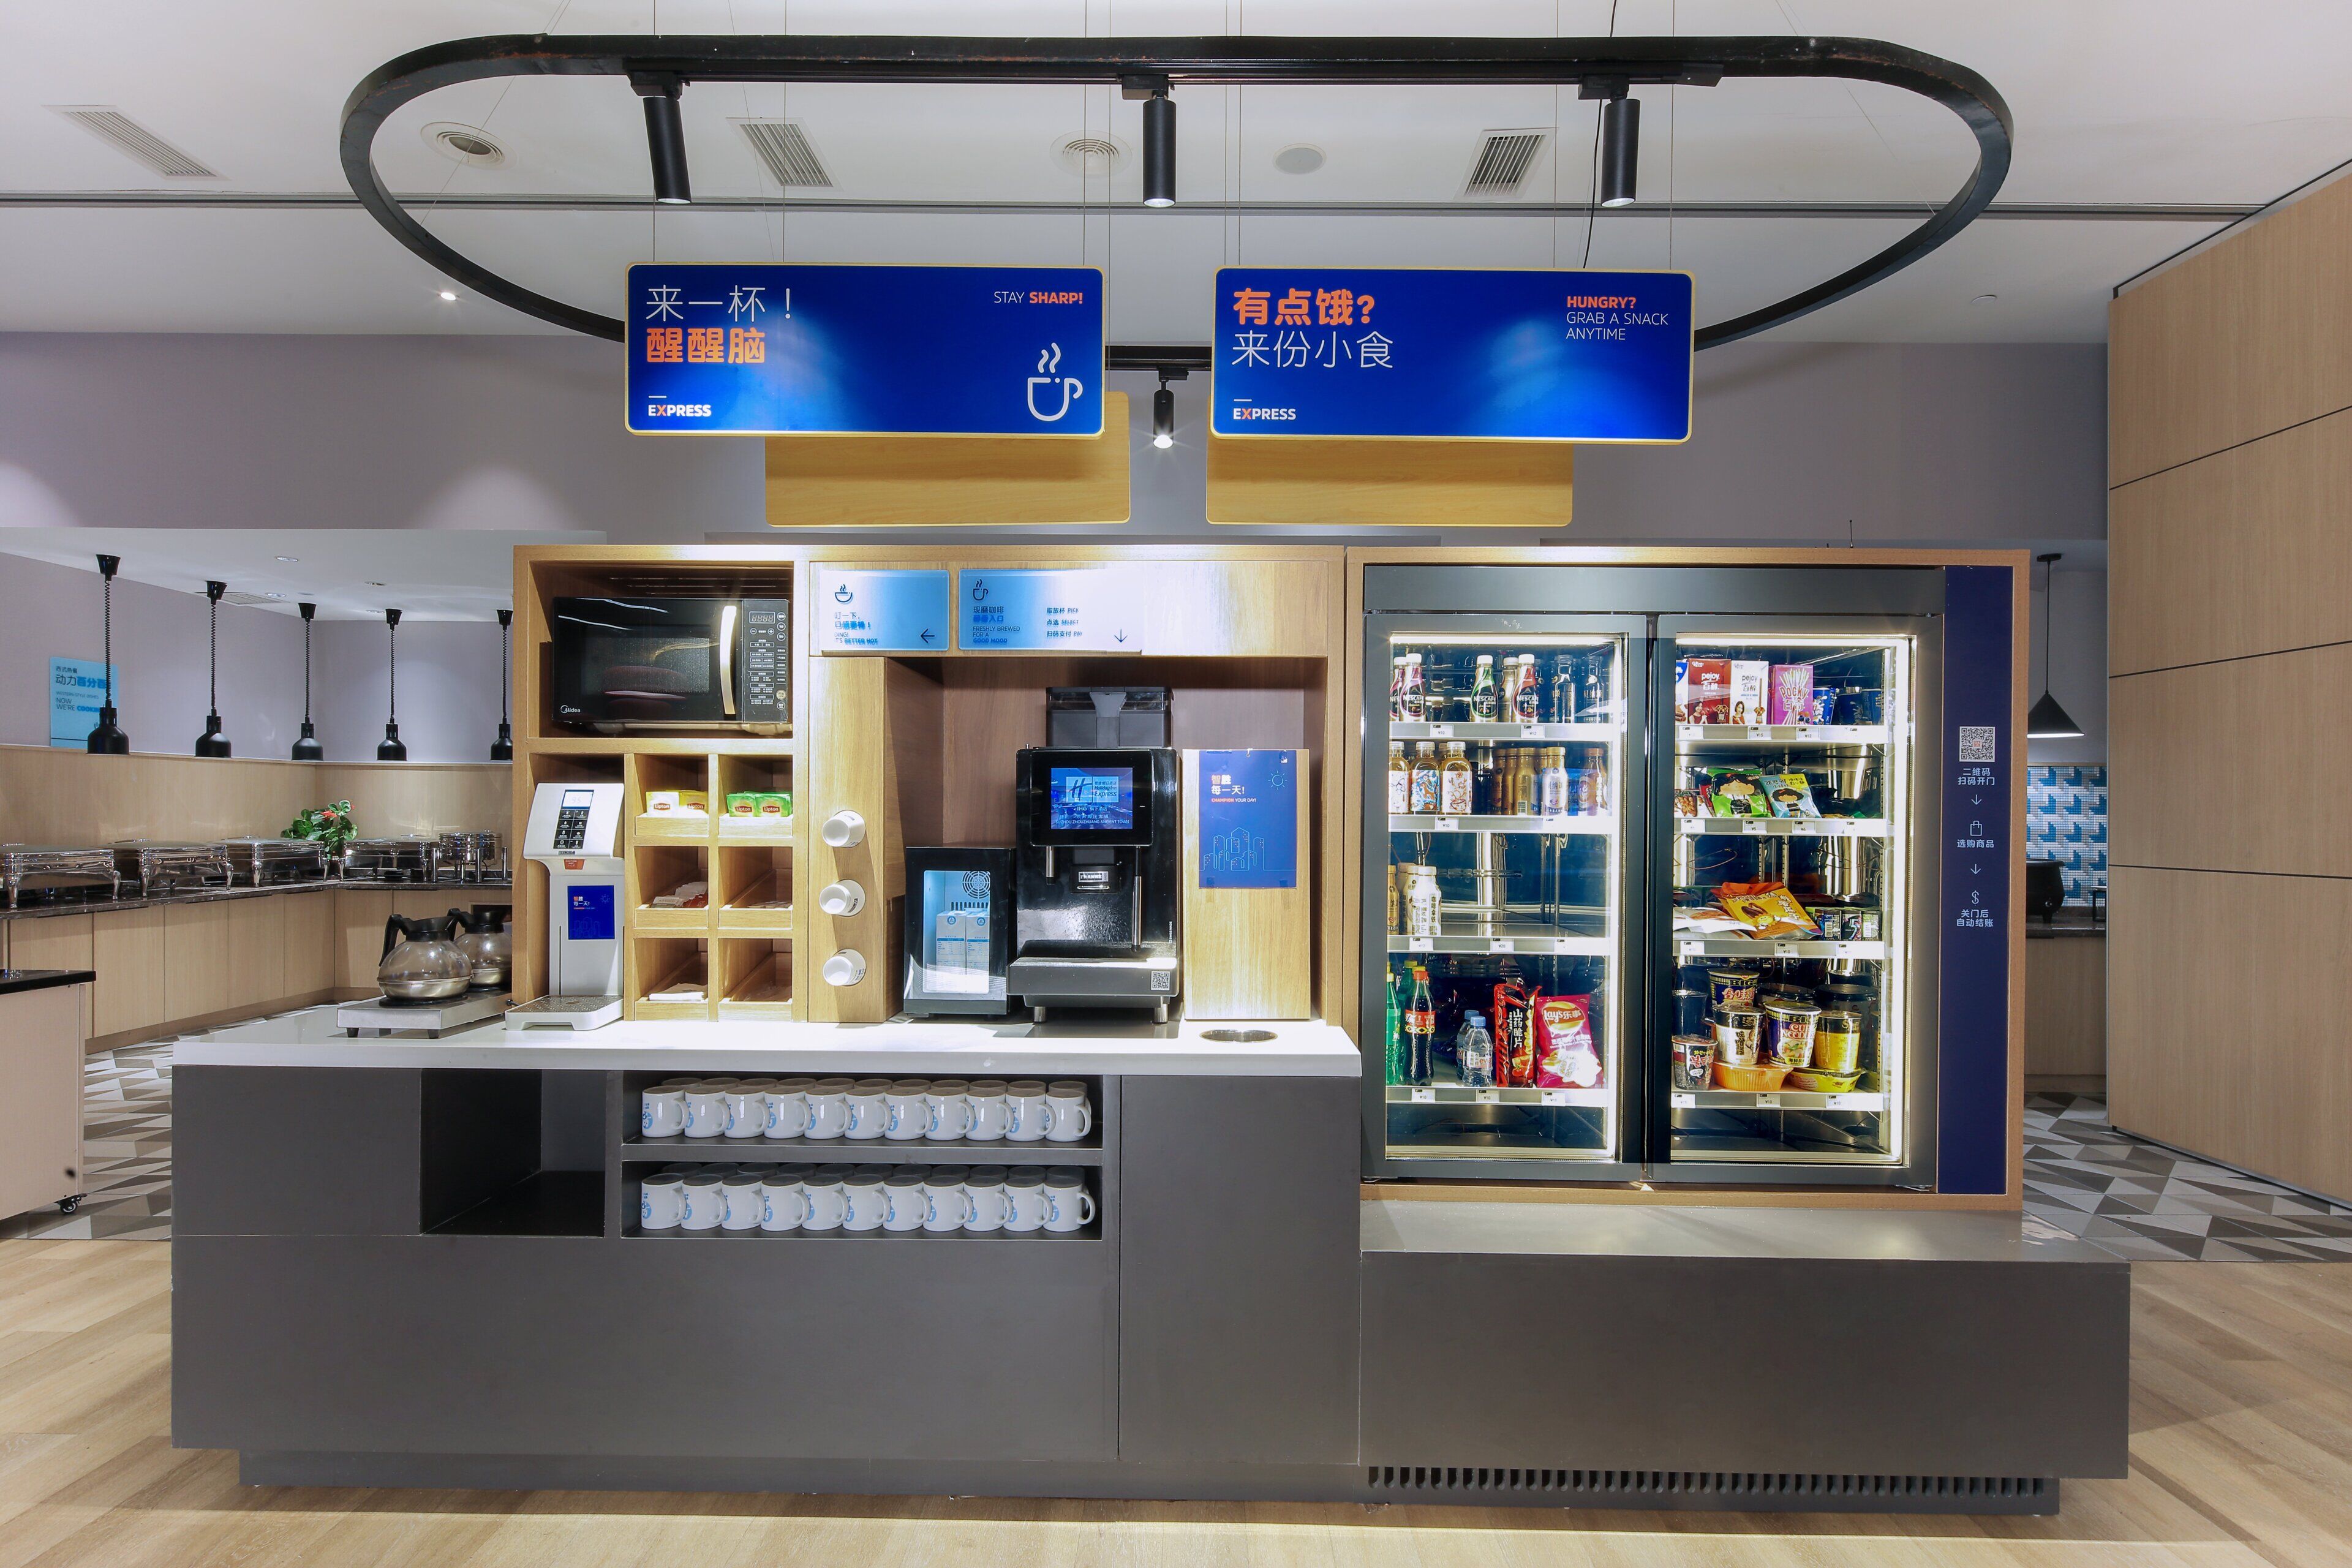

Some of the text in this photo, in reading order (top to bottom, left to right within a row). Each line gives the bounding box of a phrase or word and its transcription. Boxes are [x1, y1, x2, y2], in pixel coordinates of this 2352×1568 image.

[993, 291, 1084, 305] STAY SHARP!
[1566, 295, 1637, 309] HUNGRY?
[1566, 311, 1669, 325] GRAB A SNACK
[1566, 328, 1626, 341] ANYTIME
[646, 327, 766, 364] 醒醒脑
[1232, 330, 1394, 369] 来份小食
[648, 404, 712, 417] EXPRESS
[1233, 407, 1297, 421] EXPRESS
[1701, 672, 1719, 681] pejoy
[1779, 687, 1809, 699] POCKY
[560, 705, 581, 714] Midea
[1962, 767, 1991, 777] 二维码
[1958, 777, 1996, 785] 扫码开门
[1957, 839, 1995, 848] 选购商品
[1961, 909, 1989, 918] 关门后
[1956, 918, 1994, 927] 自动结账
[1513, 1008, 1523, 1048] 山药脆片
